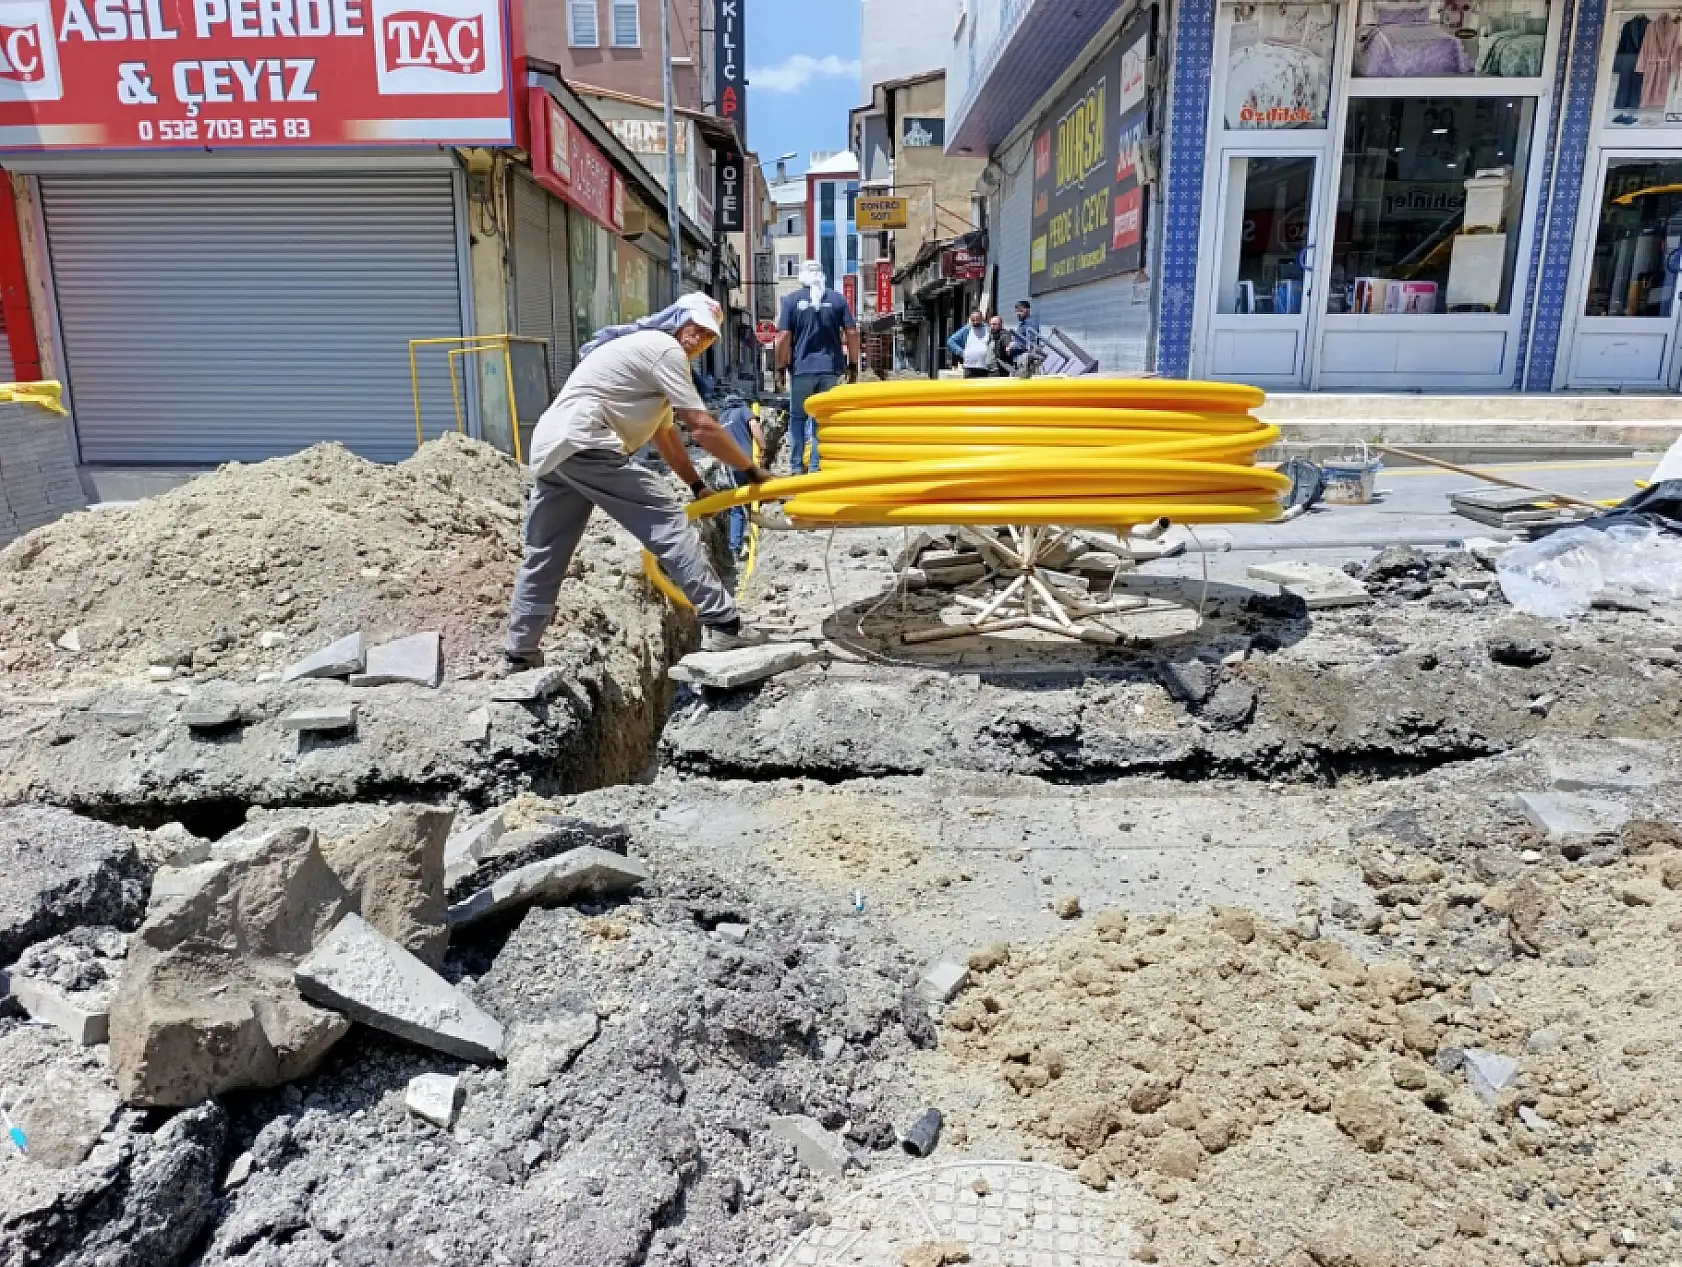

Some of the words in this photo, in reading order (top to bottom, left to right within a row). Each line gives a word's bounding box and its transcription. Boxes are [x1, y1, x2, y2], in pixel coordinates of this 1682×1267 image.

[195, 0, 365, 38] PERDE
[388, 19, 480, 74] TAÇ
[118, 61, 159, 105] &
[138, 119, 154, 142] 0
[158, 118, 200, 141] 532
[203, 118, 244, 140] 703
[249, 117, 277, 140] 25
[283, 116, 311, 140] 83
[1055, 87, 1106, 190] BURSA
[722, 165, 737, 226] OTEL
